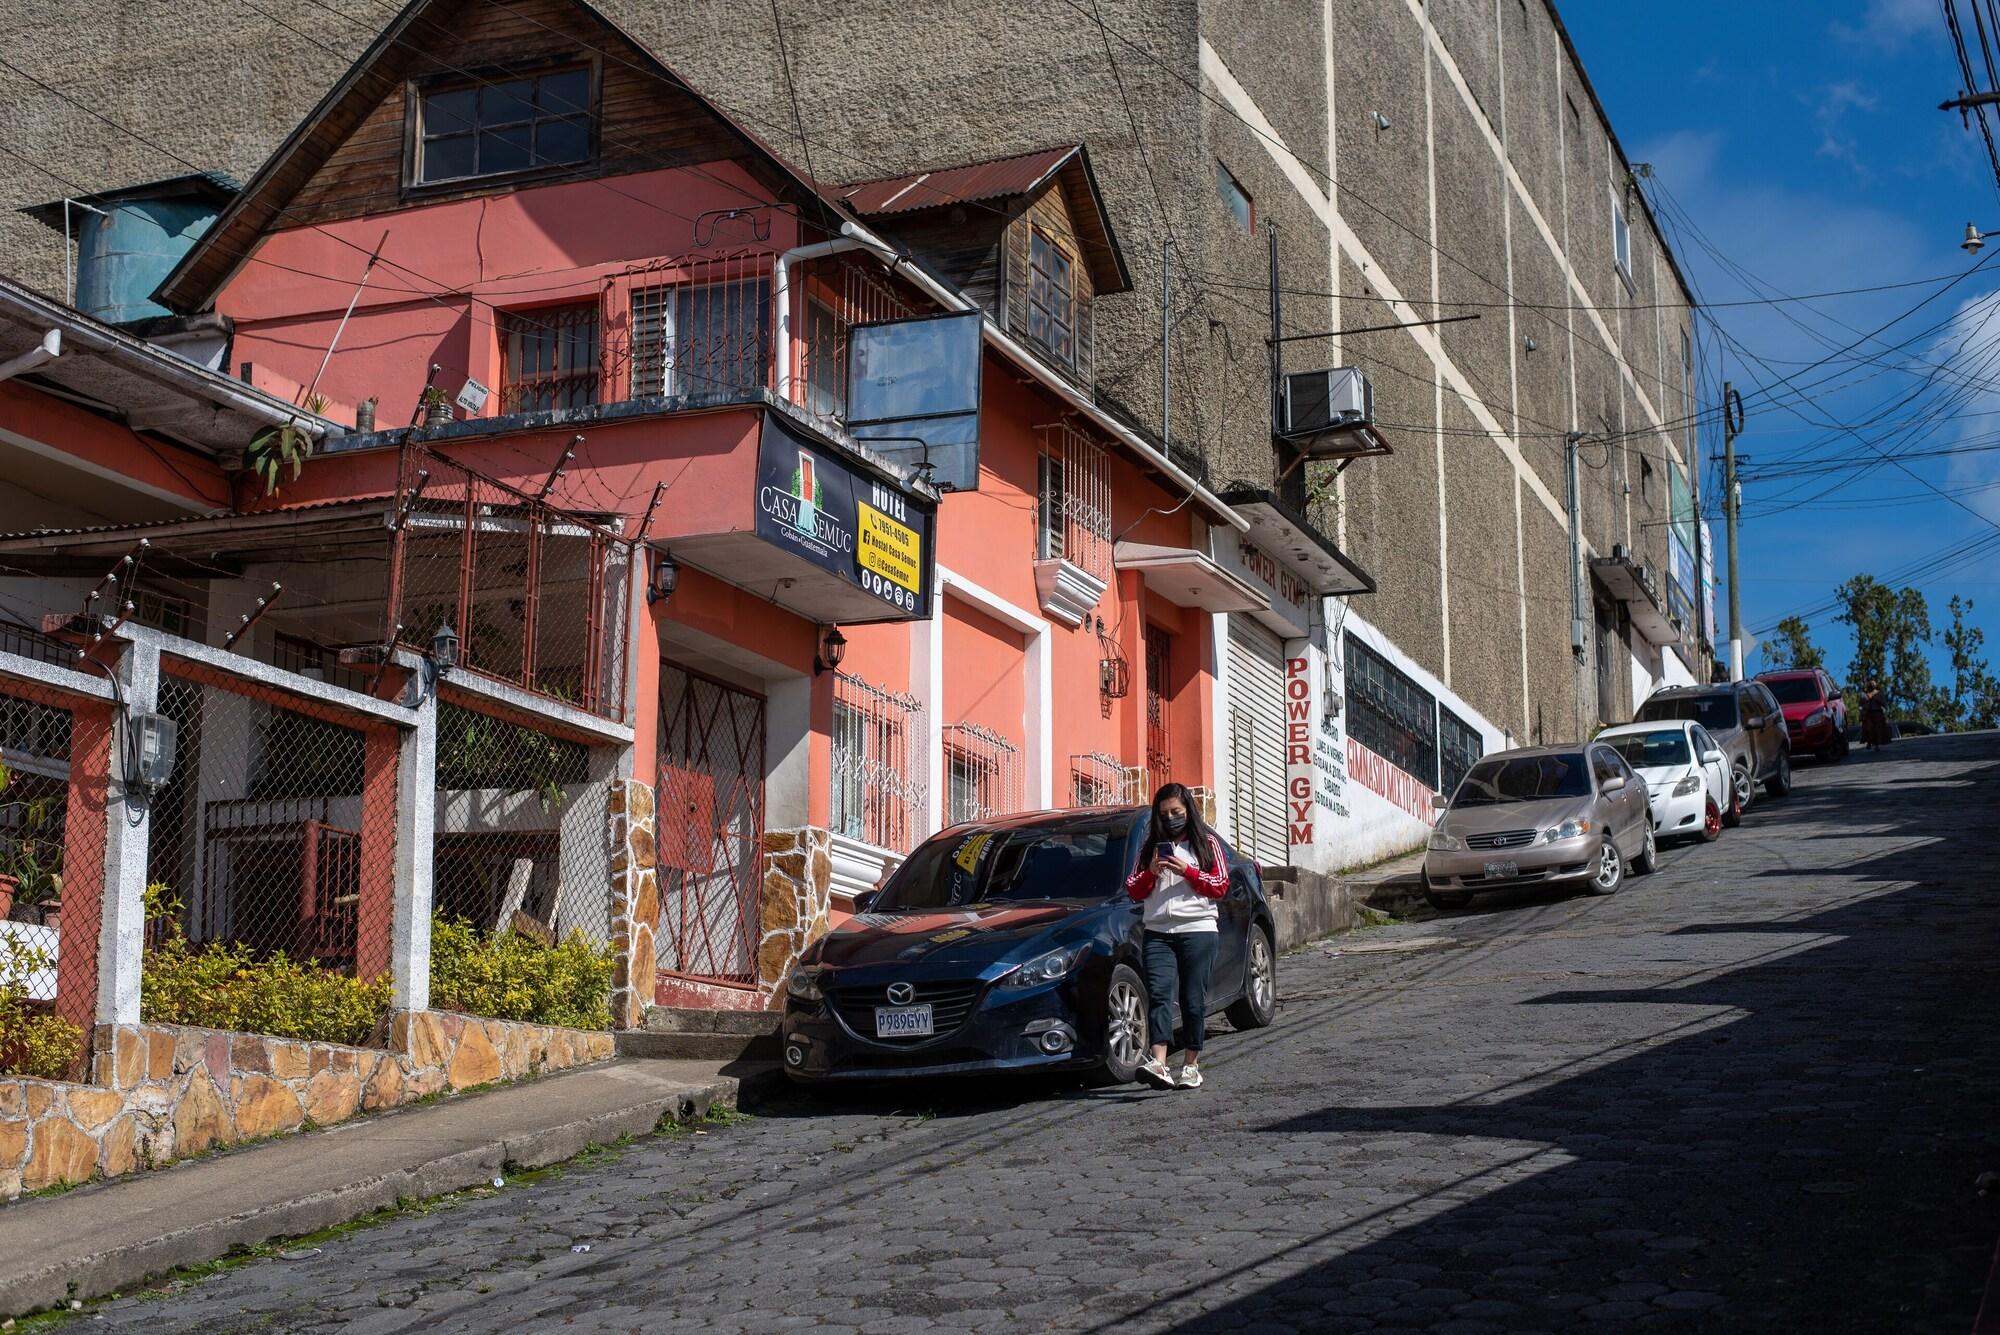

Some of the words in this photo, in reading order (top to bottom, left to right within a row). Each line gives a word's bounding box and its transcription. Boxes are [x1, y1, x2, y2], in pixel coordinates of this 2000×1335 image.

[760, 486, 798, 526] CASA
[811, 512, 852, 553] SEMUC
[872, 480, 906, 522] HOTEL
[800, 536, 828, 557] Guatemala
[879, 518, 909, 547] 7951-4505
[872, 535, 888, 552] Hostal
[889, 544, 900, 560] Casa
[901, 551, 917, 569] Semuc
[877, 557, 909, 583] @CasaSemuc
[1286, 657, 1312, 766] POWER
[1347, 738, 1385, 798] GIMNASIO
[1386, 762, 1411, 815] MIXTO
[1289, 777, 1314, 846] GYM
[878, 1012, 929, 1031] P989GYY
